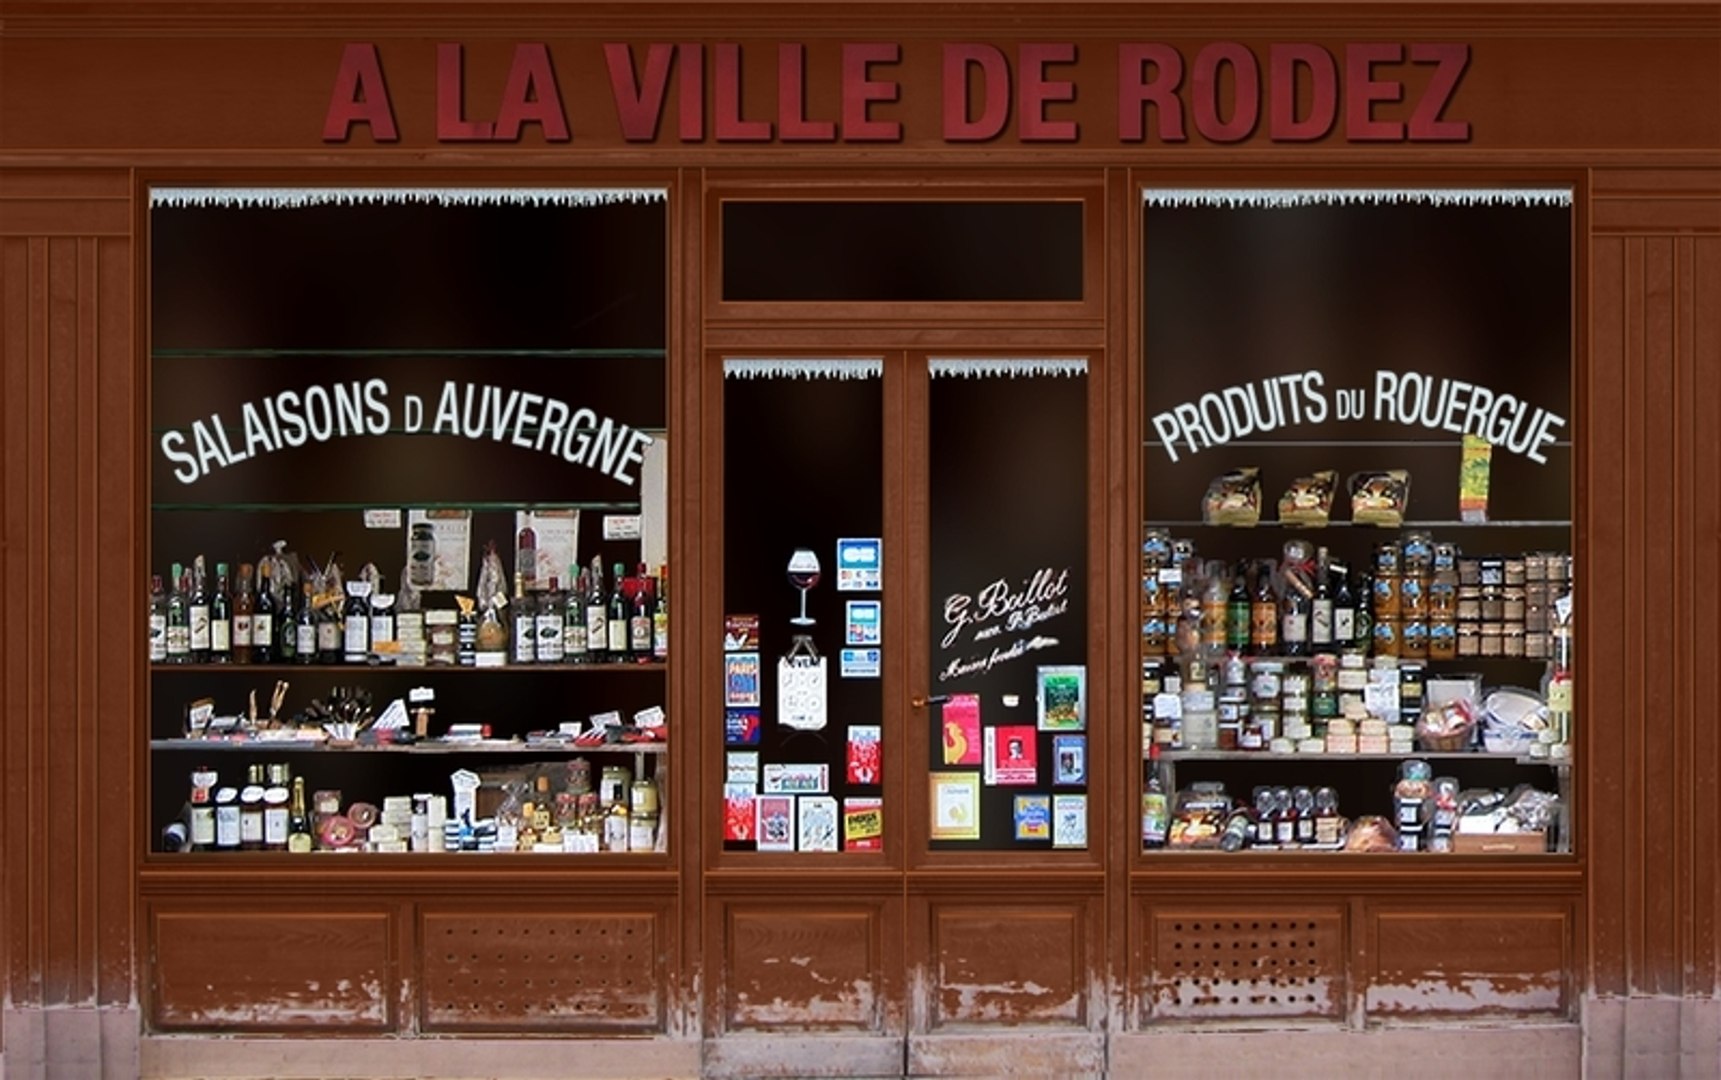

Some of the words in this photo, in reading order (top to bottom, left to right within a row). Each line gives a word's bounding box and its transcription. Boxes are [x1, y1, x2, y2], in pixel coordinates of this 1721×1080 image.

[322, 43, 397, 141] A
[436, 43, 568, 141] LA
[603, 43, 900, 141] VILLE
[942, 43, 1078, 141] DE
[1118, 42, 1470, 141] RODEZ
[160, 378, 391, 485] SALAISONS
[405, 395, 423, 433] D
[433, 381, 655, 487] AUVERGNE
[1151, 370, 1328, 463] PRODUITS
[1336, 389, 1365, 421] DU
[1374, 370, 1566, 465] ROUERGUE
